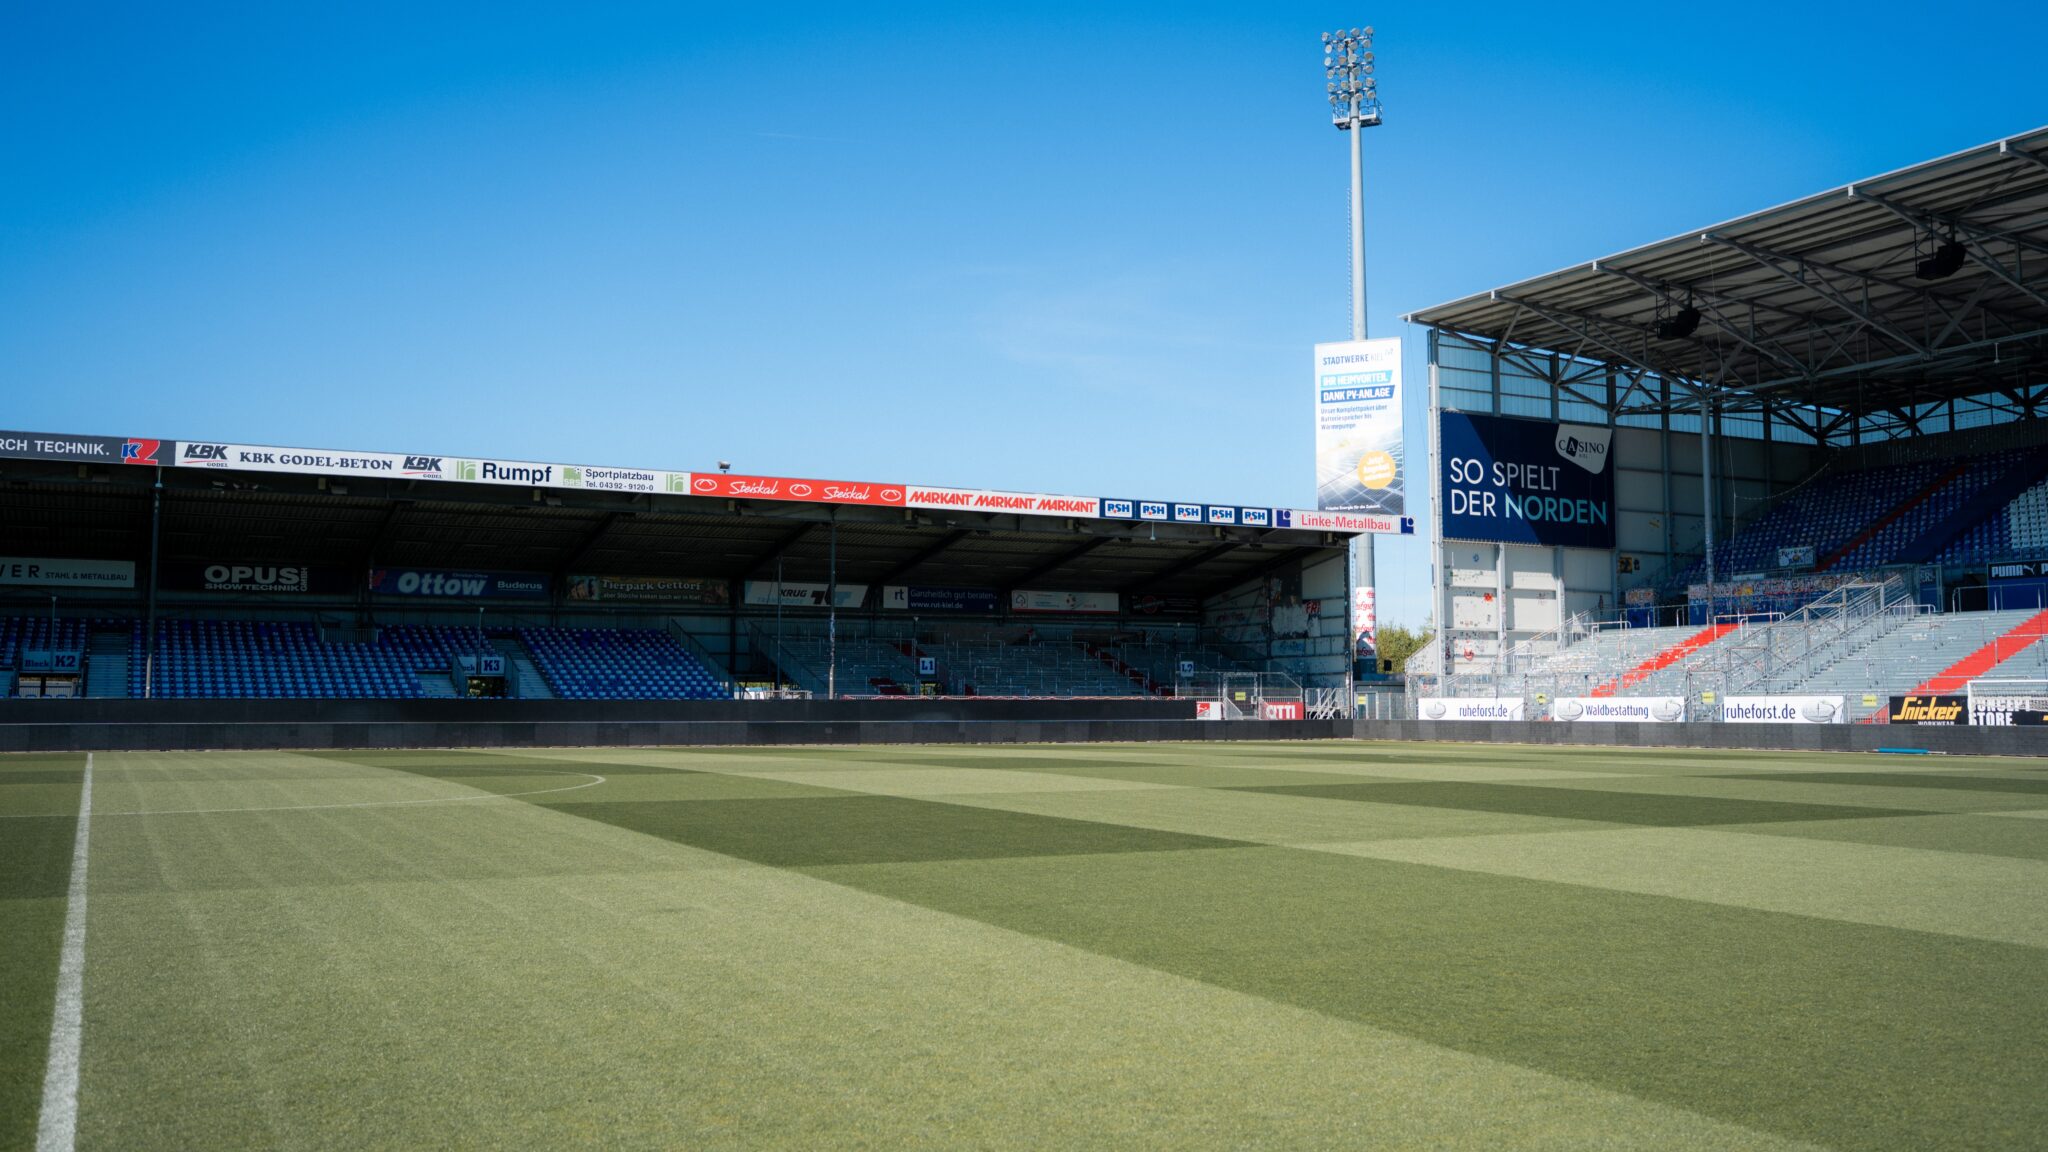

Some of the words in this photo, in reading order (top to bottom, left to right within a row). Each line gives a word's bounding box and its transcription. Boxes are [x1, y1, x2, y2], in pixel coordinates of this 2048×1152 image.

[1323, 354, 1369, 366] STADTWERKE
[1323, 391, 1345, 400] DANK
[1347, 387, 1391, 400] PV-ANLAGE
[34, 440, 110, 456] TECHNIK.
[184, 443, 229, 460] KBK
[1558, 438, 1605, 454] CASINO
[239, 452, 275, 464] KBK
[280, 454, 392, 470] GODEL-BETON
[402, 456, 442, 472] KBK
[482, 462, 552, 485] Rumpf
[585, 468, 654, 481] Sportplatzbau
[1450, 457, 1484, 485] SO
[1492, 462, 1560, 491] SPIELT
[729, 479, 779, 496] Steiskal
[823, 485, 870, 500] Steiskal
[909, 491, 974, 506] MARKANT
[974, 495, 1036, 510] MARKANT
[1037, 499, 1097, 513] MARKANT
[1451, 489, 1497, 517] DER
[1505, 492, 1607, 526] NORDEN
[1301, 513, 1391, 532] Linke-Metallbau
[45, 572, 70, 580] STAHL
[72, 572, 78, 580] &
[80, 572, 127, 581] METALLBAU
[204, 565, 300, 585] OPUS
[1992, 564, 2024, 578] PUMA
[204, 583, 300, 591] SHOWTECHNIK
[397, 571, 487, 596] Ottow
[497, 580, 543, 590] Buderus
[602, 579, 654, 592] Tierpark
[657, 580, 701, 590] Gettorf
[780, 589, 808, 598] KRUG
[910, 589, 952, 600] Ganzheitlich
[954, 591, 966, 601] gut
[55, 655, 76, 668] K2
[483, 660, 500, 672] K3
[921, 660, 933, 671] L1
[1459, 703, 1508, 718] ruheforst.de
[1585, 704, 1649, 719] Waldbestattung
[1726, 702, 1796, 720] ruheforst.de
